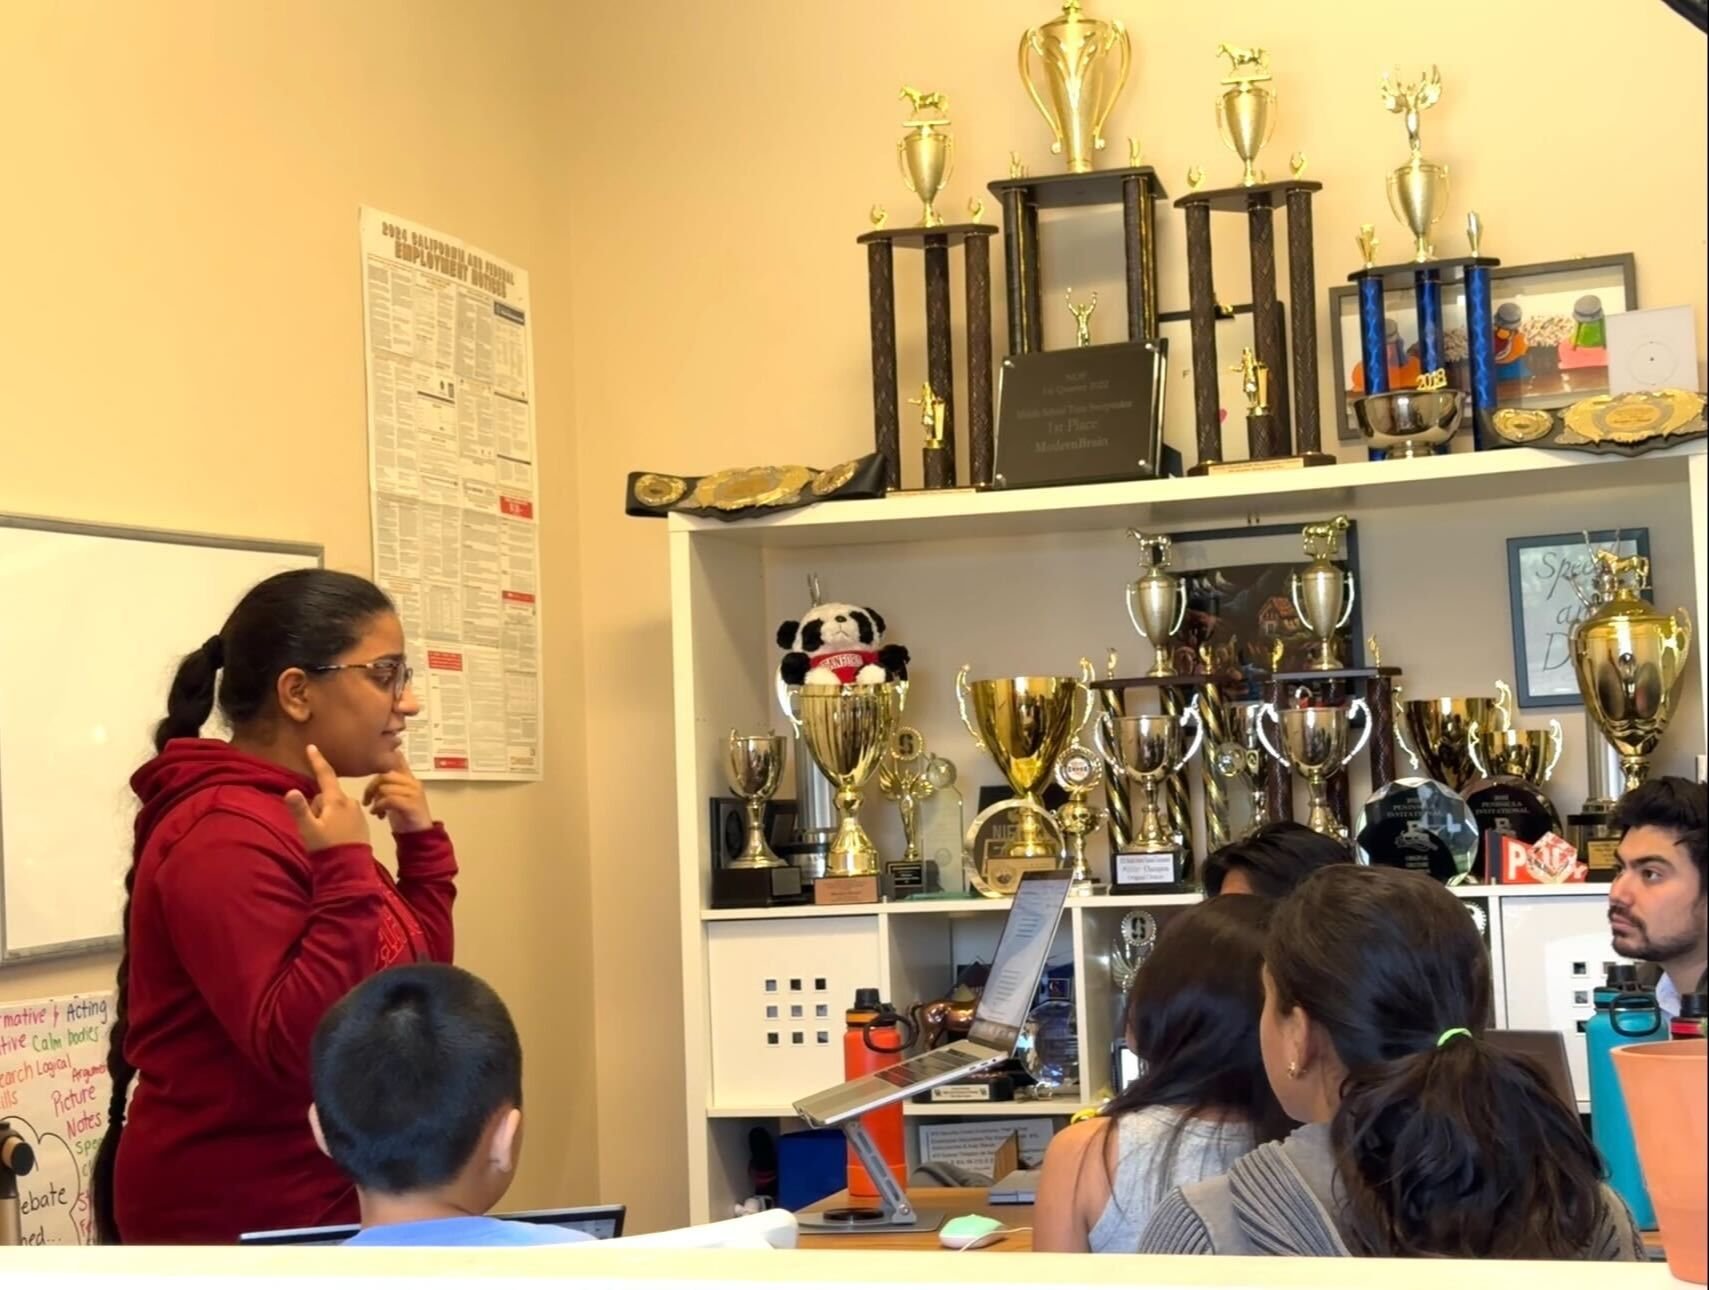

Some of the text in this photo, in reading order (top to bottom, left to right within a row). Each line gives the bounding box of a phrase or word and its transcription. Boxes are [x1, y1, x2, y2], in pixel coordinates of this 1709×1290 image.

[394, 240, 468, 283] EMPLOYMENT
[1067, 418, 1098, 432] Place
[1034, 437, 1110, 453] ModernBrain
[1536, 552, 1593, 600] Spee
[0, 1000, 108, 1029] mative Acting
[0, 1026, 99, 1056] tive Calm bodies
[0, 1053, 72, 1089] earch Logical
[51, 1086, 96, 1118] Picture
[67, 1111, 102, 1139] Notes
[21, 1182, 68, 1215] ebate
